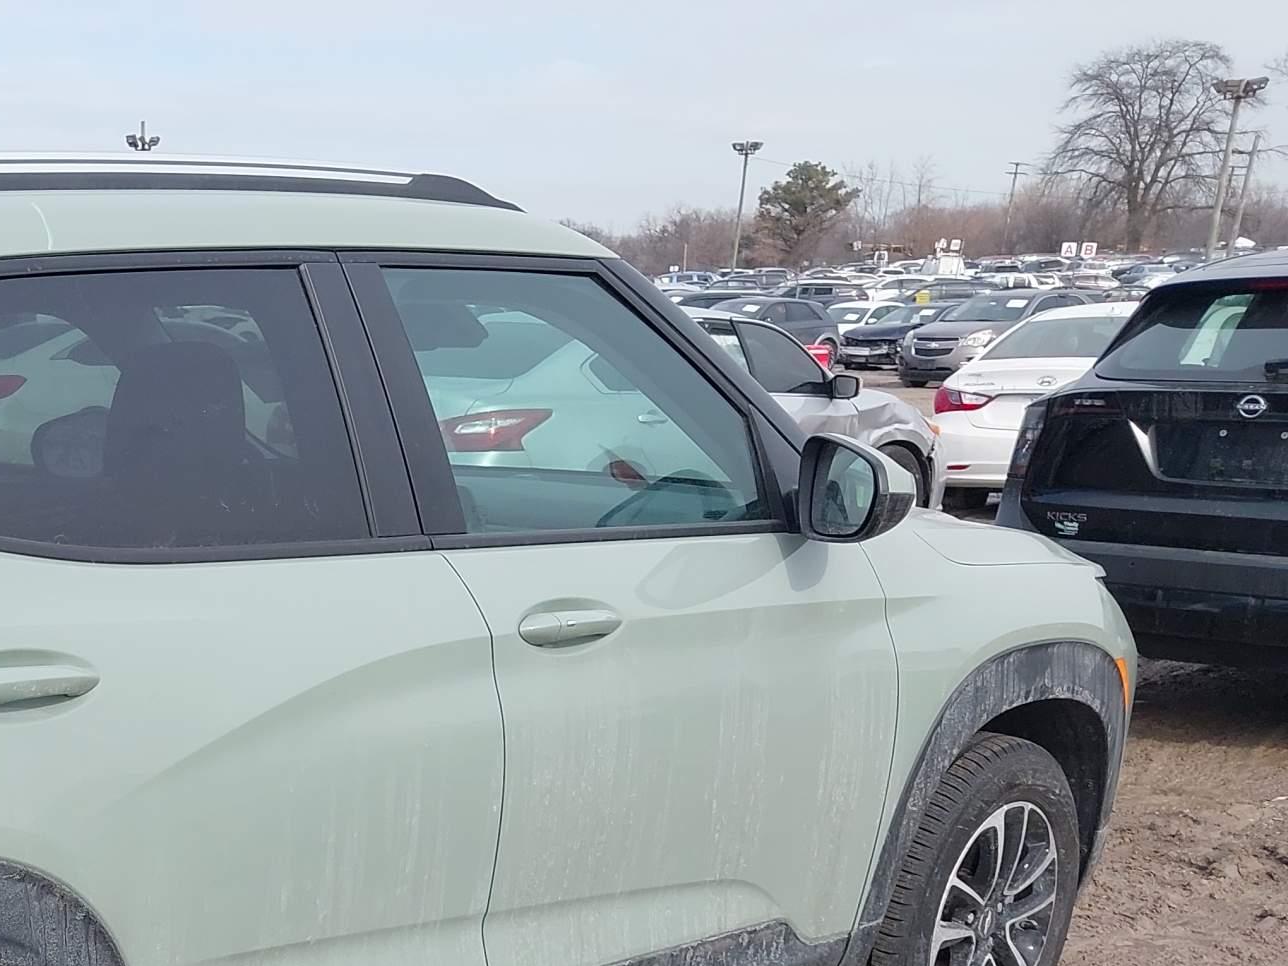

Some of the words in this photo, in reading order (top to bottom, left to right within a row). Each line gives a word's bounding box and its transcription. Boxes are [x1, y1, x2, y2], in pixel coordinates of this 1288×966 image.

[1064, 244, 1073, 255] A
[1084, 244, 1094, 255] B
[1047, 511, 1087, 522] KICKS
